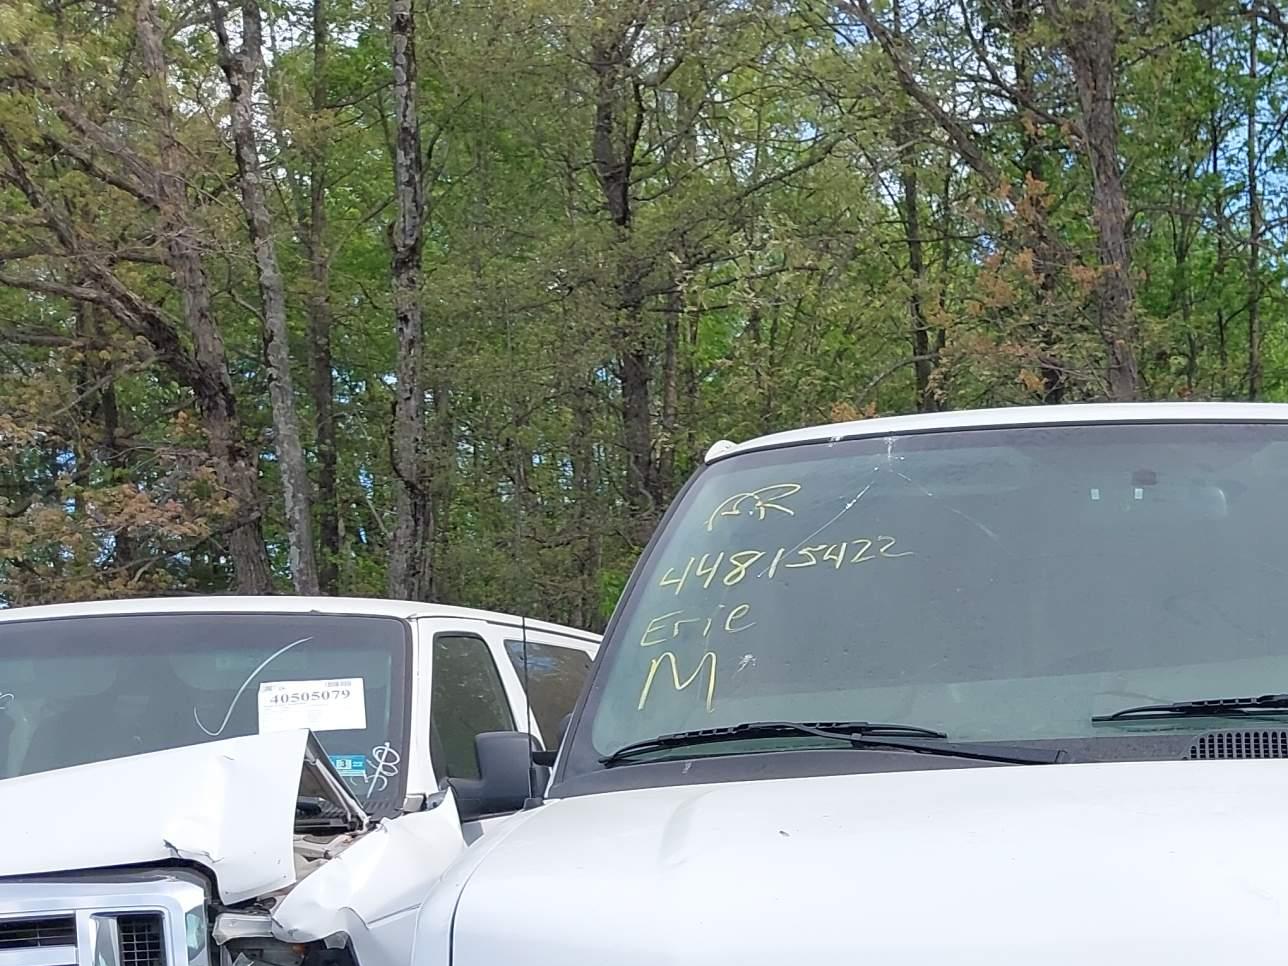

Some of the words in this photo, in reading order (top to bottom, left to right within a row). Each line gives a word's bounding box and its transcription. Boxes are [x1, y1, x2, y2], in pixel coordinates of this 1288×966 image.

[659, 535, 915, 596] 44815422
[639, 603, 756, 648] Erie
[269, 689, 351, 704] 40505079
[638, 651, 717, 713] M
